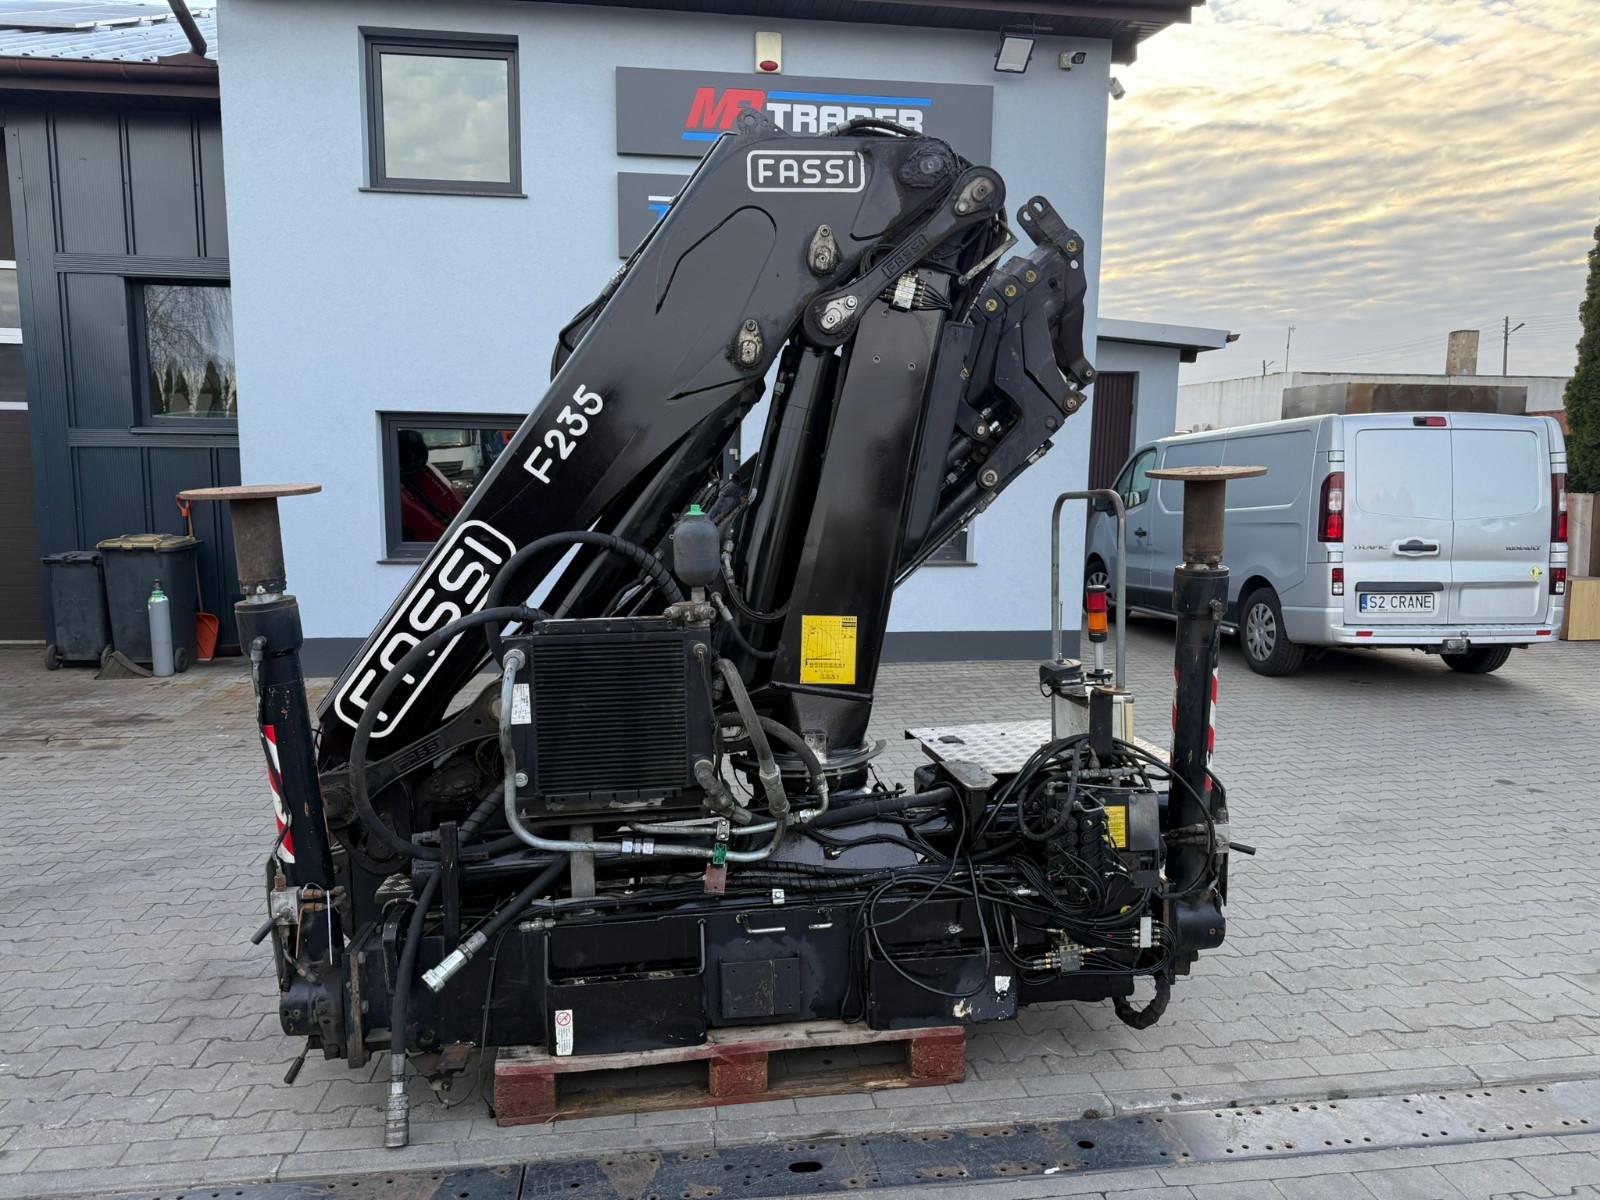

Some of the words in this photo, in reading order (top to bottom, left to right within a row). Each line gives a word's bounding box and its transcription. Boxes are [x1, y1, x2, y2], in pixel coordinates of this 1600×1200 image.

[758, 158, 854, 185] FASSI
[523, 384, 604, 484] F235
[1370, 595, 1386, 609] S2
[1390, 595, 1432, 609] CRANE
